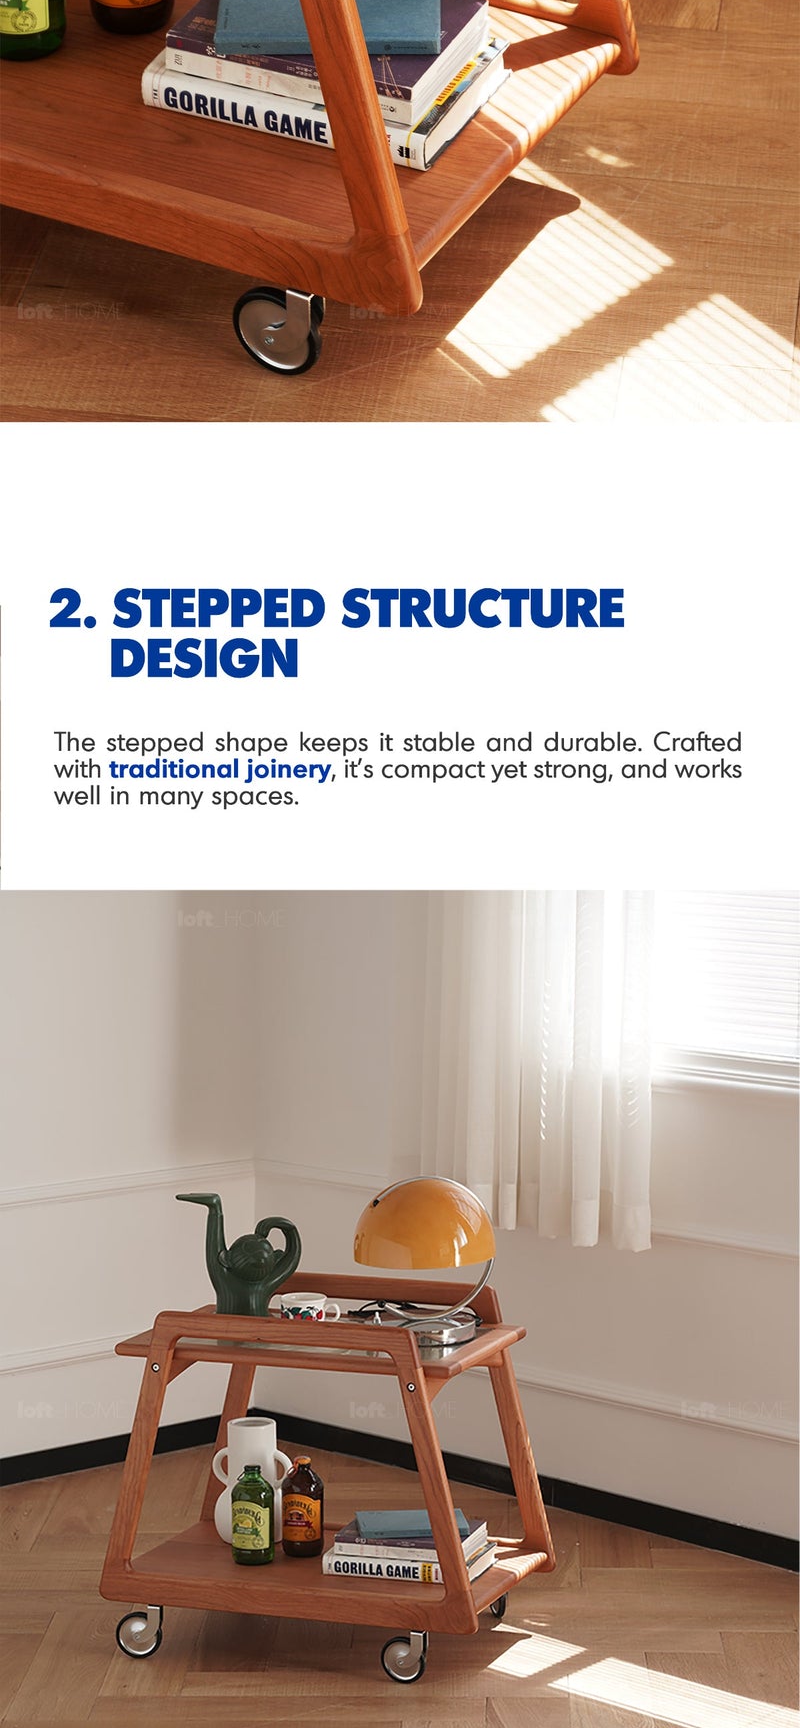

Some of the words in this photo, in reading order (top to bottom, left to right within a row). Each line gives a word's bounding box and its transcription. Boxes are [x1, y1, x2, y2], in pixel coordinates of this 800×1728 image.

[163, 86, 259, 128] GORILLA
[264, 109, 329, 145] GAME
[334, 1560, 383, 1576] GORILLA
[386, 1564, 420, 1579] GAME
